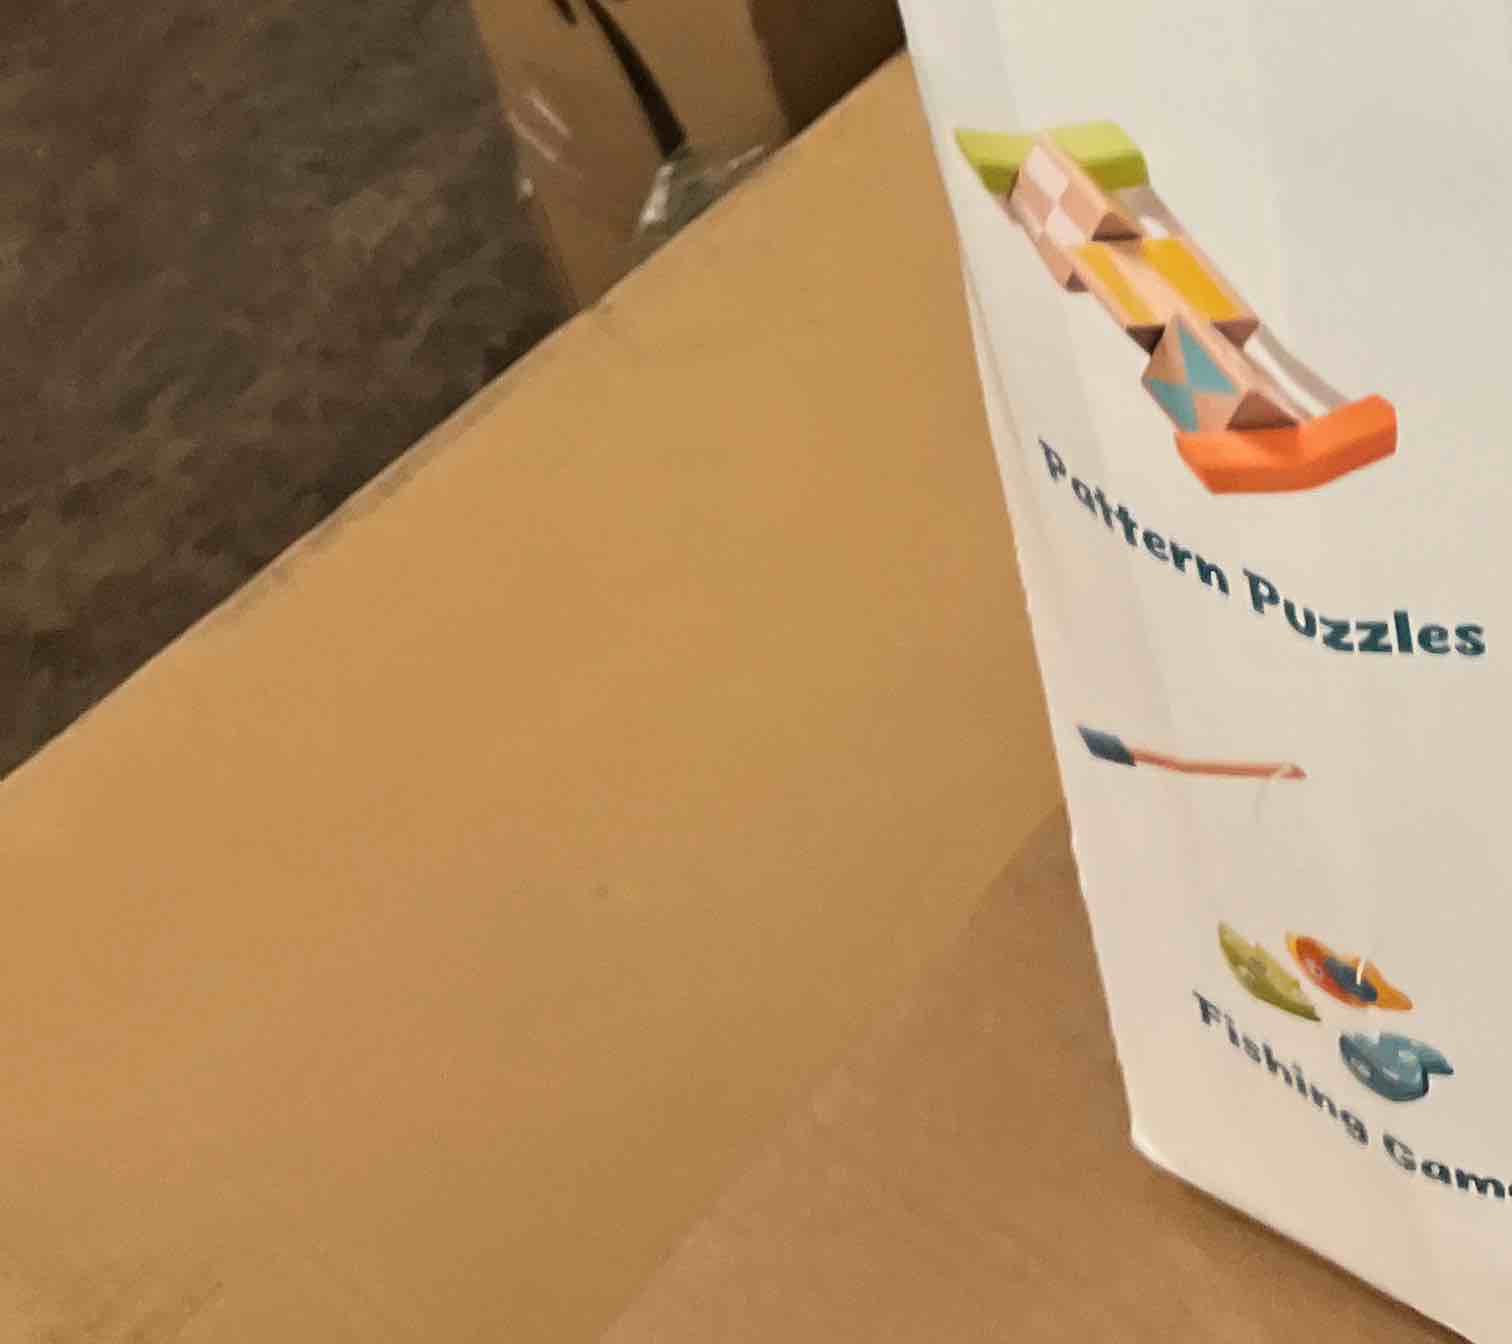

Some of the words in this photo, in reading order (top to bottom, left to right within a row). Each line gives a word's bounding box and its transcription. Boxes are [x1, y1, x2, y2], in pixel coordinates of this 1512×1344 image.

[1038, 436, 1231, 596] Pattern
[1242, 566, 1487, 657] Puzzles
[1192, 989, 1369, 1146] Fishing
